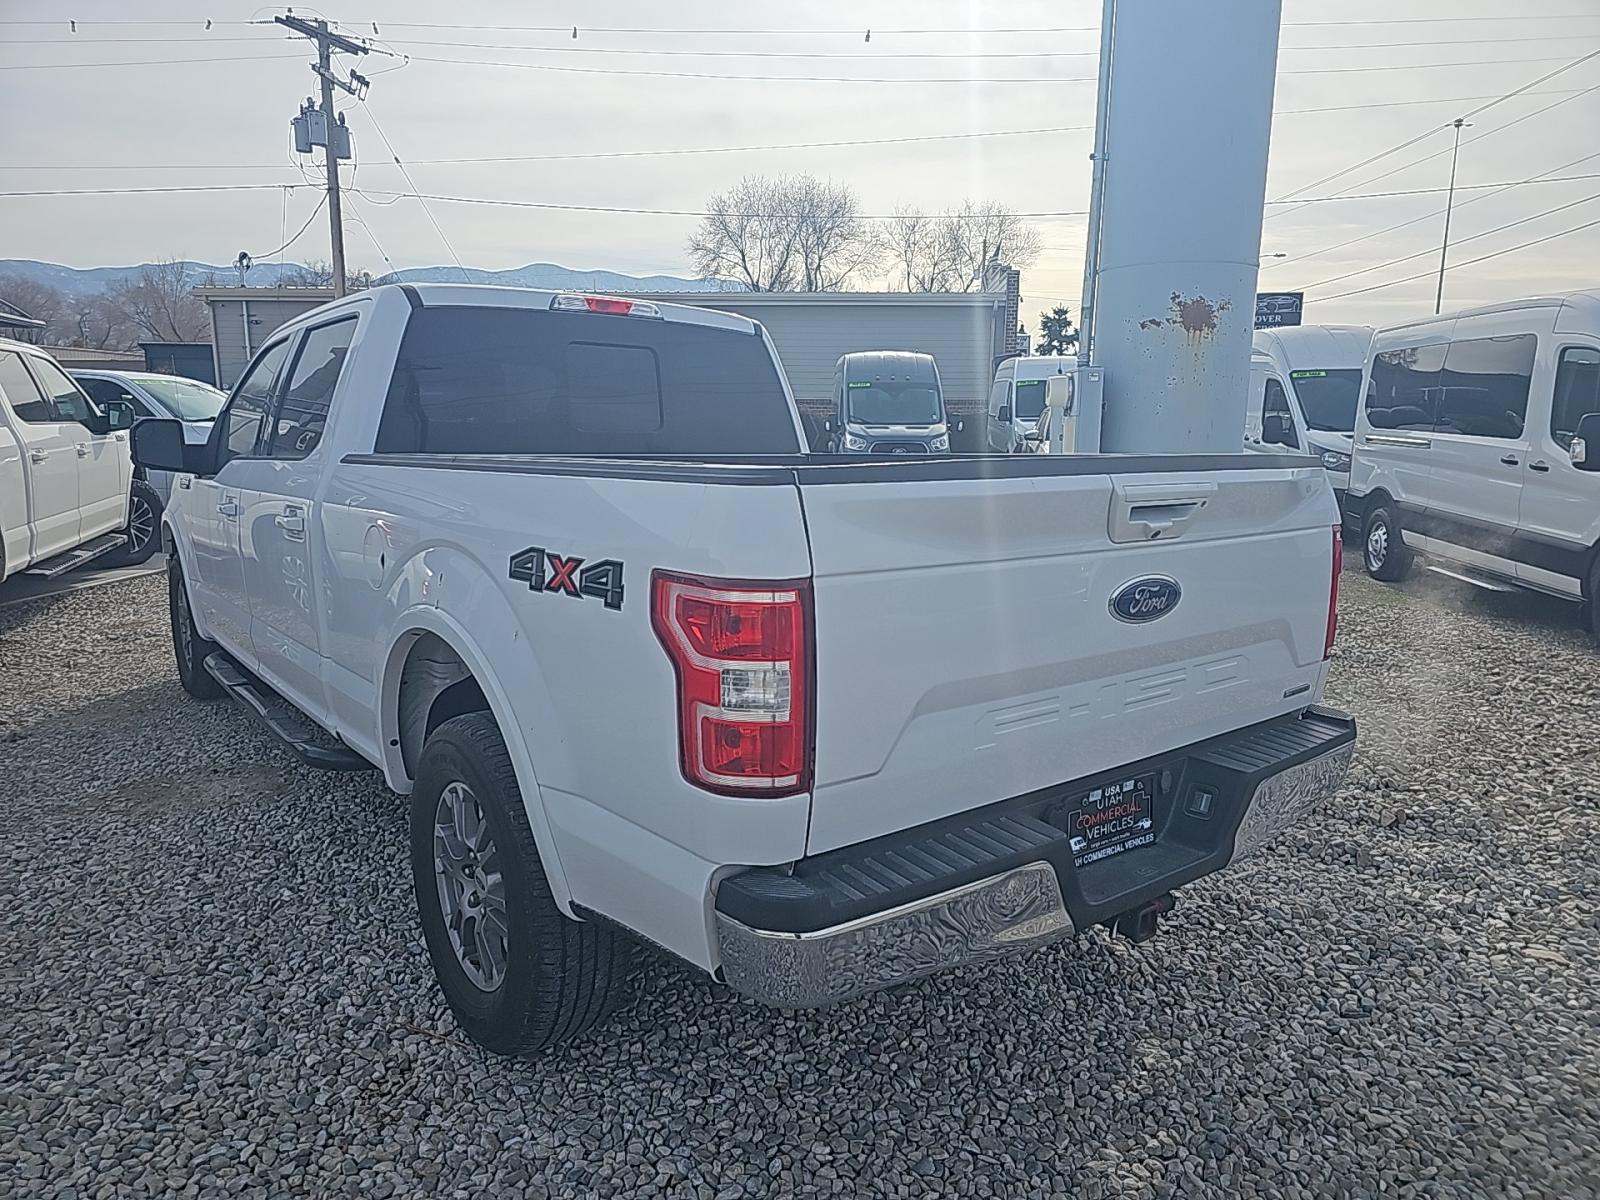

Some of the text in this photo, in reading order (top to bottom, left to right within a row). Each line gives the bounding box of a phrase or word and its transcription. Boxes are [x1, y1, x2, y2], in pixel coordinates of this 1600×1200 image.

[1130, 585, 1170, 614] Ford
[1105, 785, 1120, 796] USA
[1077, 802, 1141, 829] COMMERCIAL
[1086, 816, 1134, 839] VEHICLES
[1083, 843, 1124, 864] COMMERCIAL
[1125, 833, 1154, 849] VEHICLES
